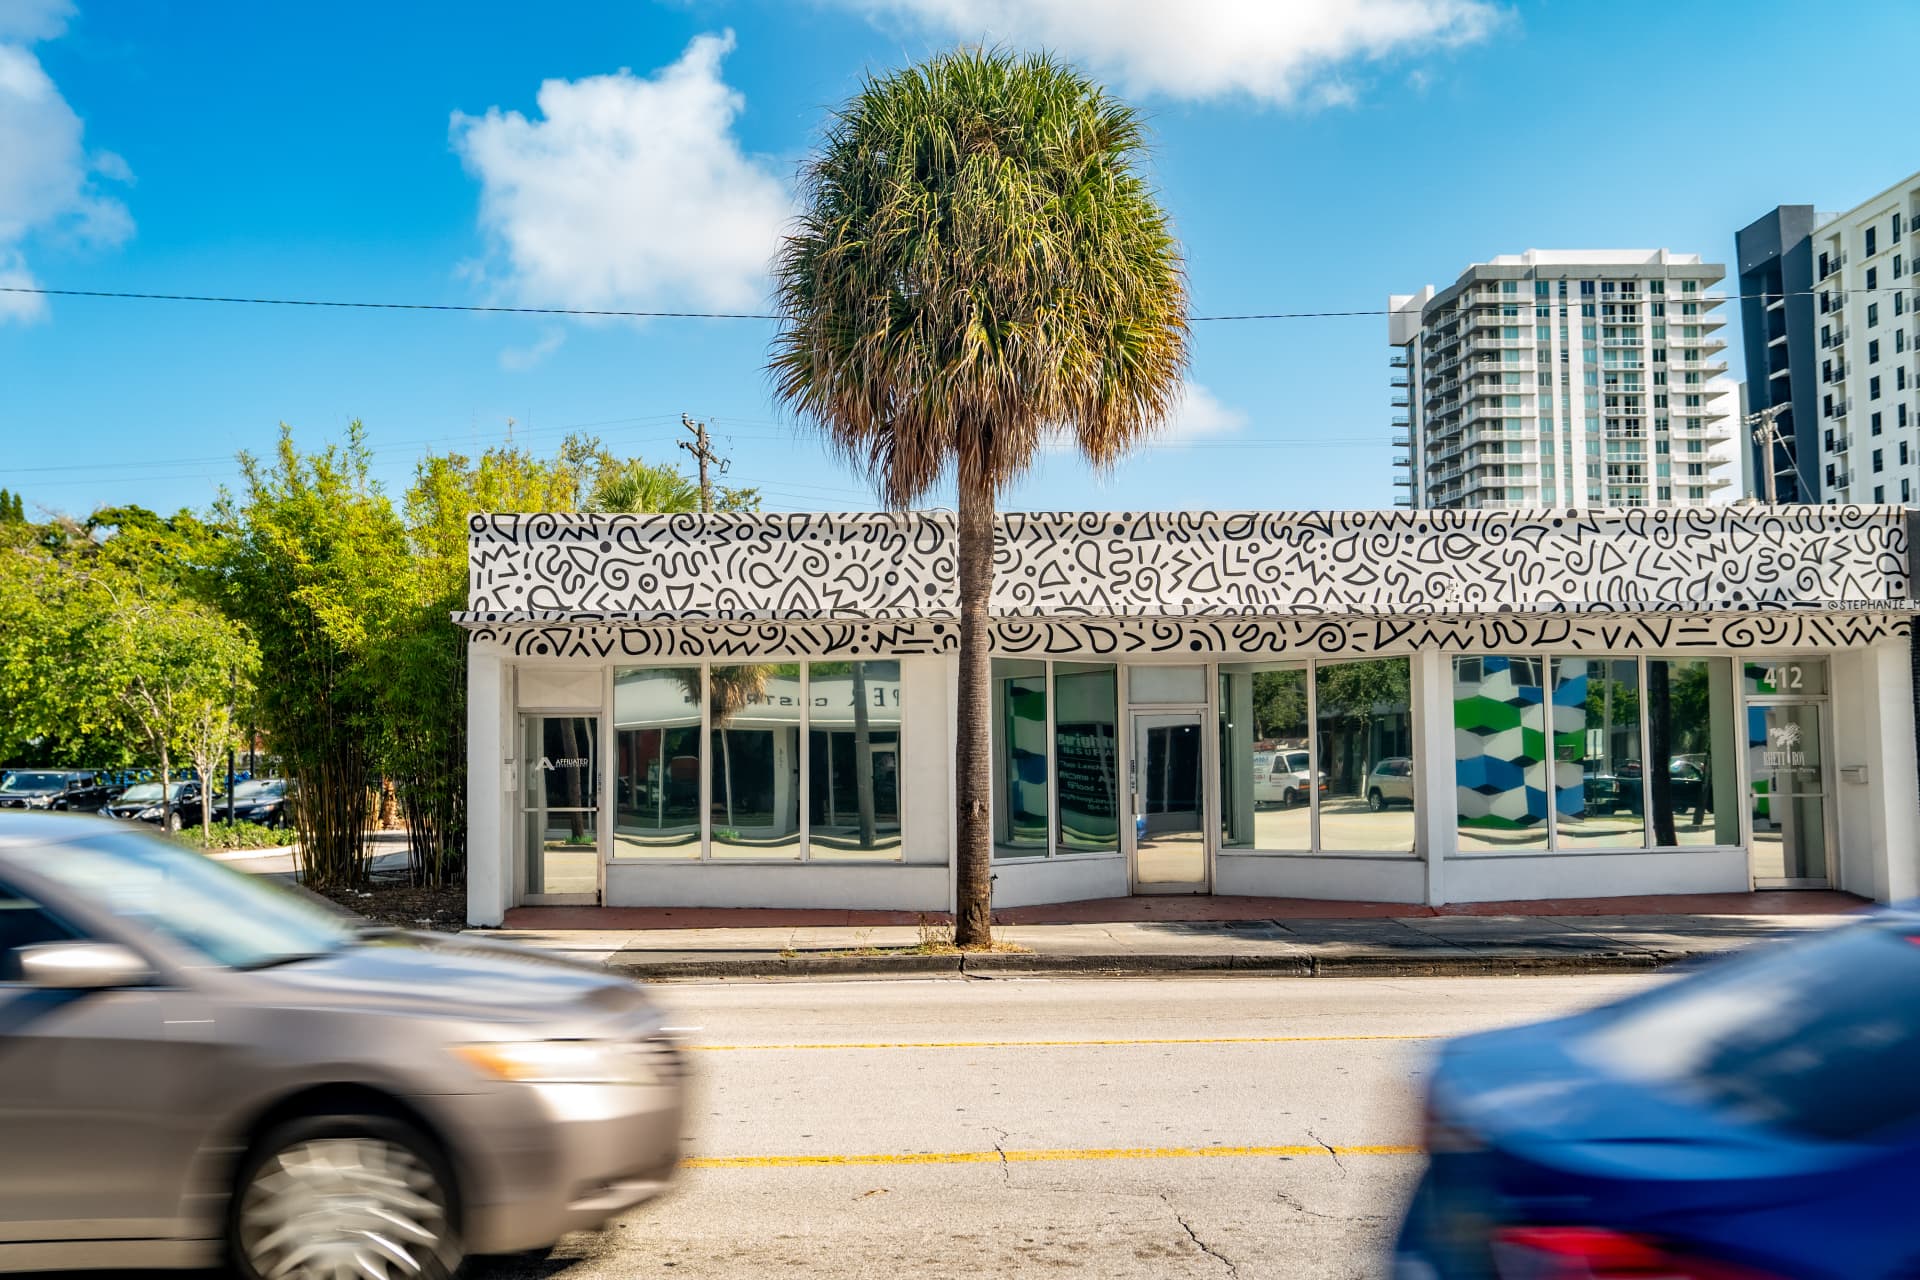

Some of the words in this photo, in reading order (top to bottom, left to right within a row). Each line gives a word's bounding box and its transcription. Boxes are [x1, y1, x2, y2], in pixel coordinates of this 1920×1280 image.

[1764, 666, 1802, 688] 412
[1764, 752, 1785, 765] RHETT
[1791, 752, 1805, 766] ROY
